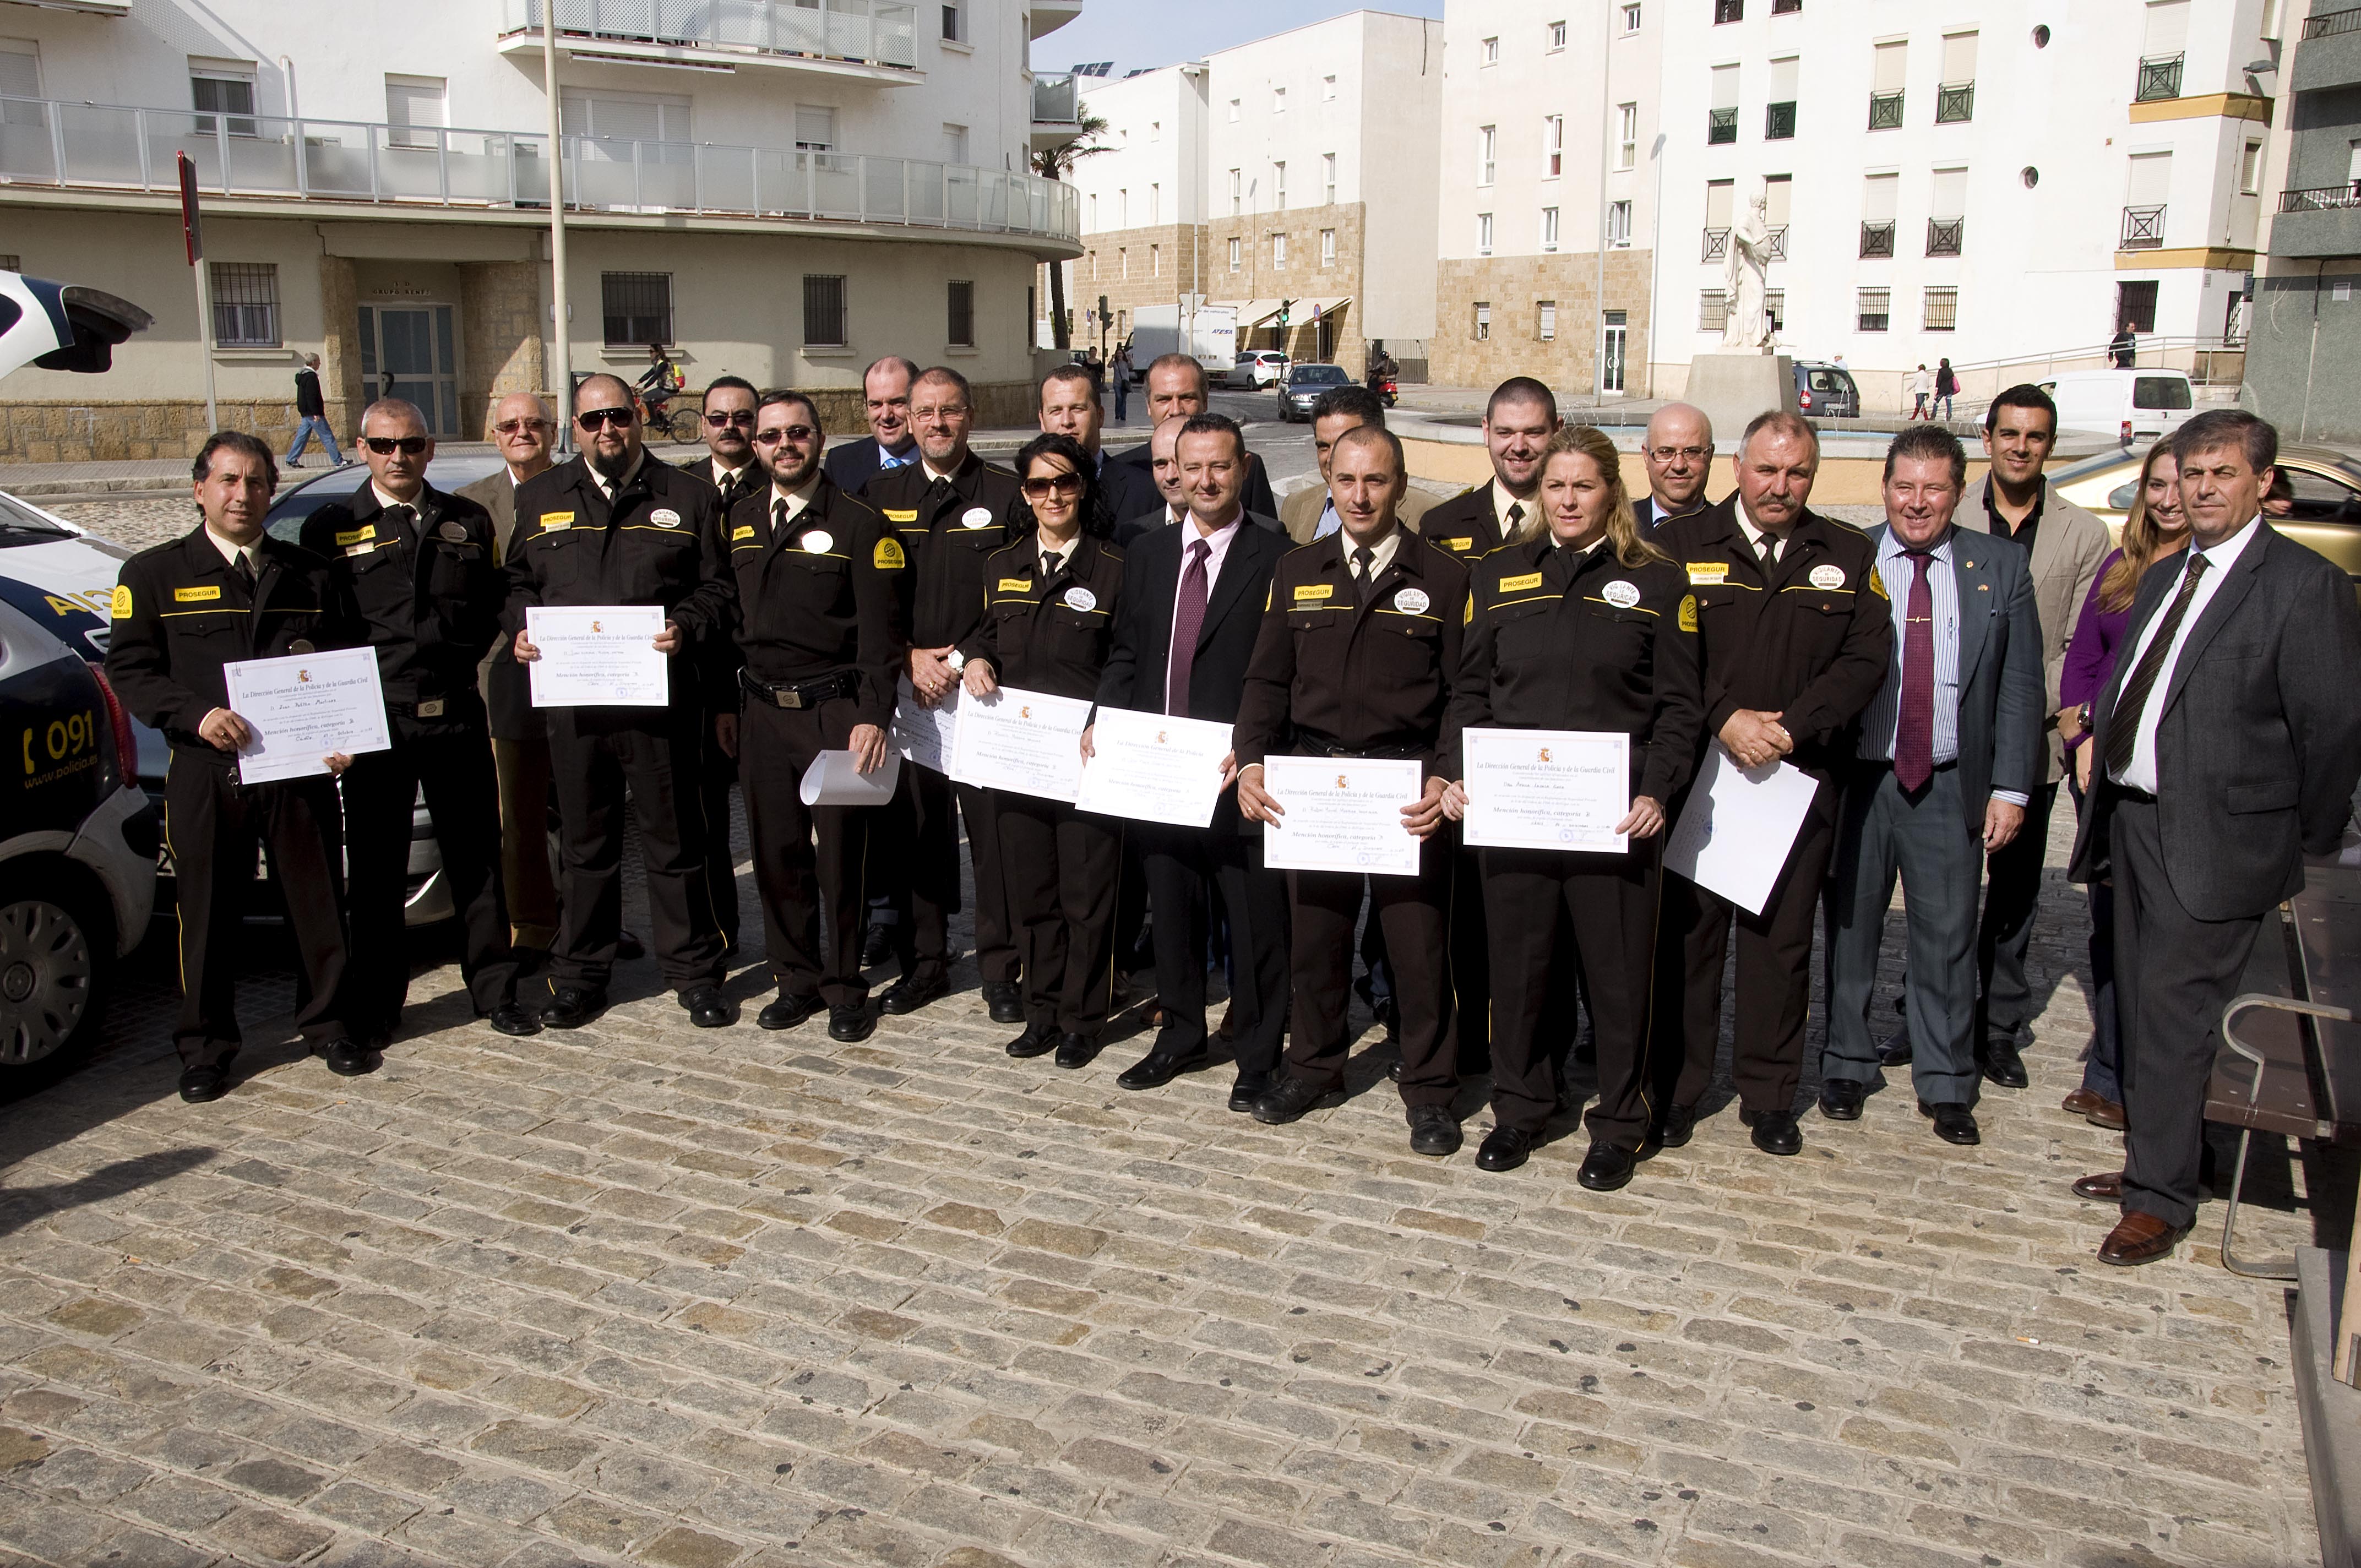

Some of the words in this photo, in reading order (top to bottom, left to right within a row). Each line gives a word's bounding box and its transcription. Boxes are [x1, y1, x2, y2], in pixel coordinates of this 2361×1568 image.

[339, 529, 372, 541] PROSEGUR
[1503, 578, 1538, 587] PROSEGUR
[179, 590, 217, 598] PROSEGUR
[1070, 589, 1094, 601] VIGILANTE
[1067, 595, 1093, 608] SEGURIDAD
[1397, 600, 1427, 608] SEGURIDAD
[264, 727, 288, 736] Mención
[1053, 725, 1070, 734] Guardia
[47, 709, 94, 760] 091
[976, 751, 997, 759] Mención
[24, 754, 98, 790] www.policia.es
